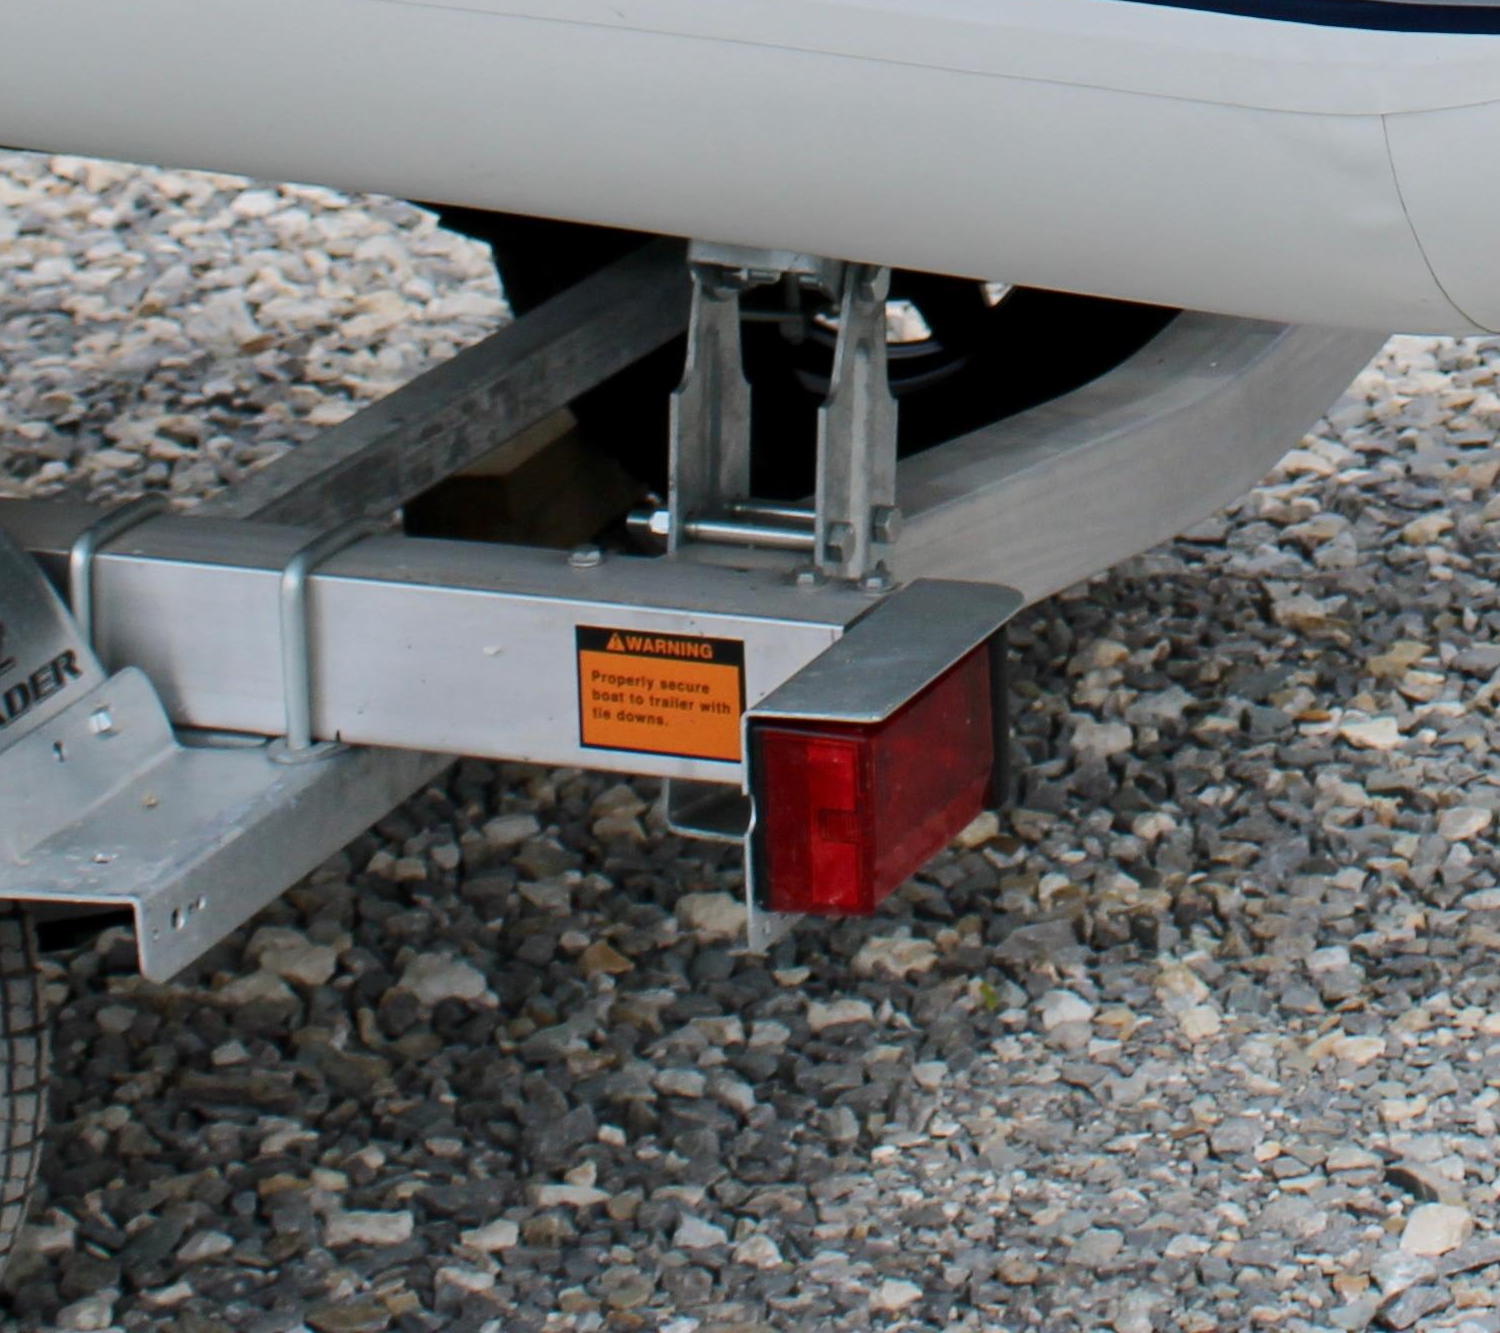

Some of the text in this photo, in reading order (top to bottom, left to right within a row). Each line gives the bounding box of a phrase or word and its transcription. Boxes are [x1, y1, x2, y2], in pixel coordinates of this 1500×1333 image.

[626, 635, 713, 659] WARNING
[591, 669, 710, 695] Properly secure
[592, 689, 731, 715] boat to trailer with
[592, 707, 669, 727] tie downs.
